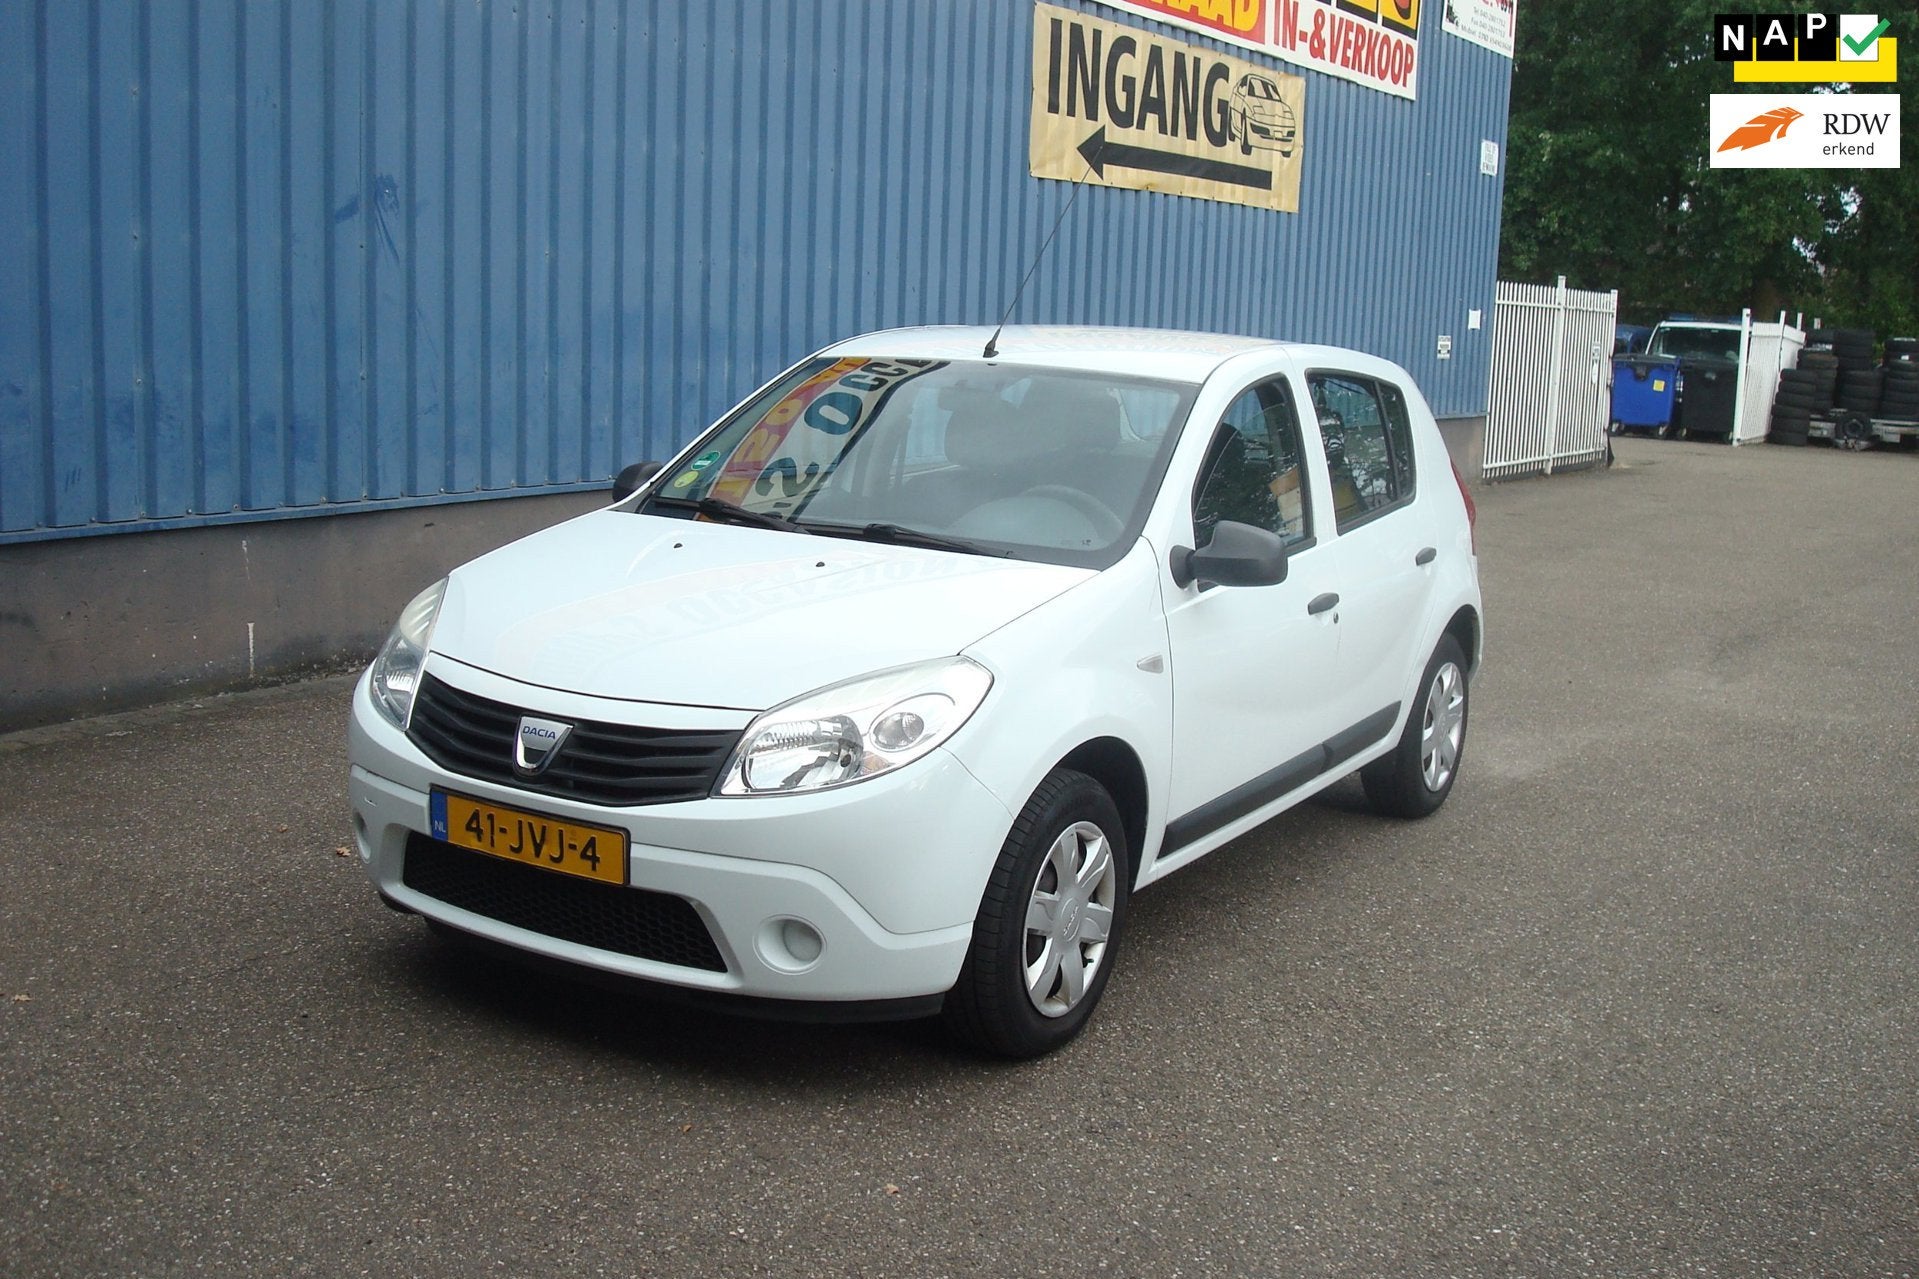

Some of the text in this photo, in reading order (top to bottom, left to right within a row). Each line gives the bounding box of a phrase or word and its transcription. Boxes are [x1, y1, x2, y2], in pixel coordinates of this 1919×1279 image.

[1048, 17, 1230, 148] INGANG
[523, 725, 556, 740] DACIA
[434, 820, 446, 833] NL
[465, 808, 601, 872] 41-JVJ-4
